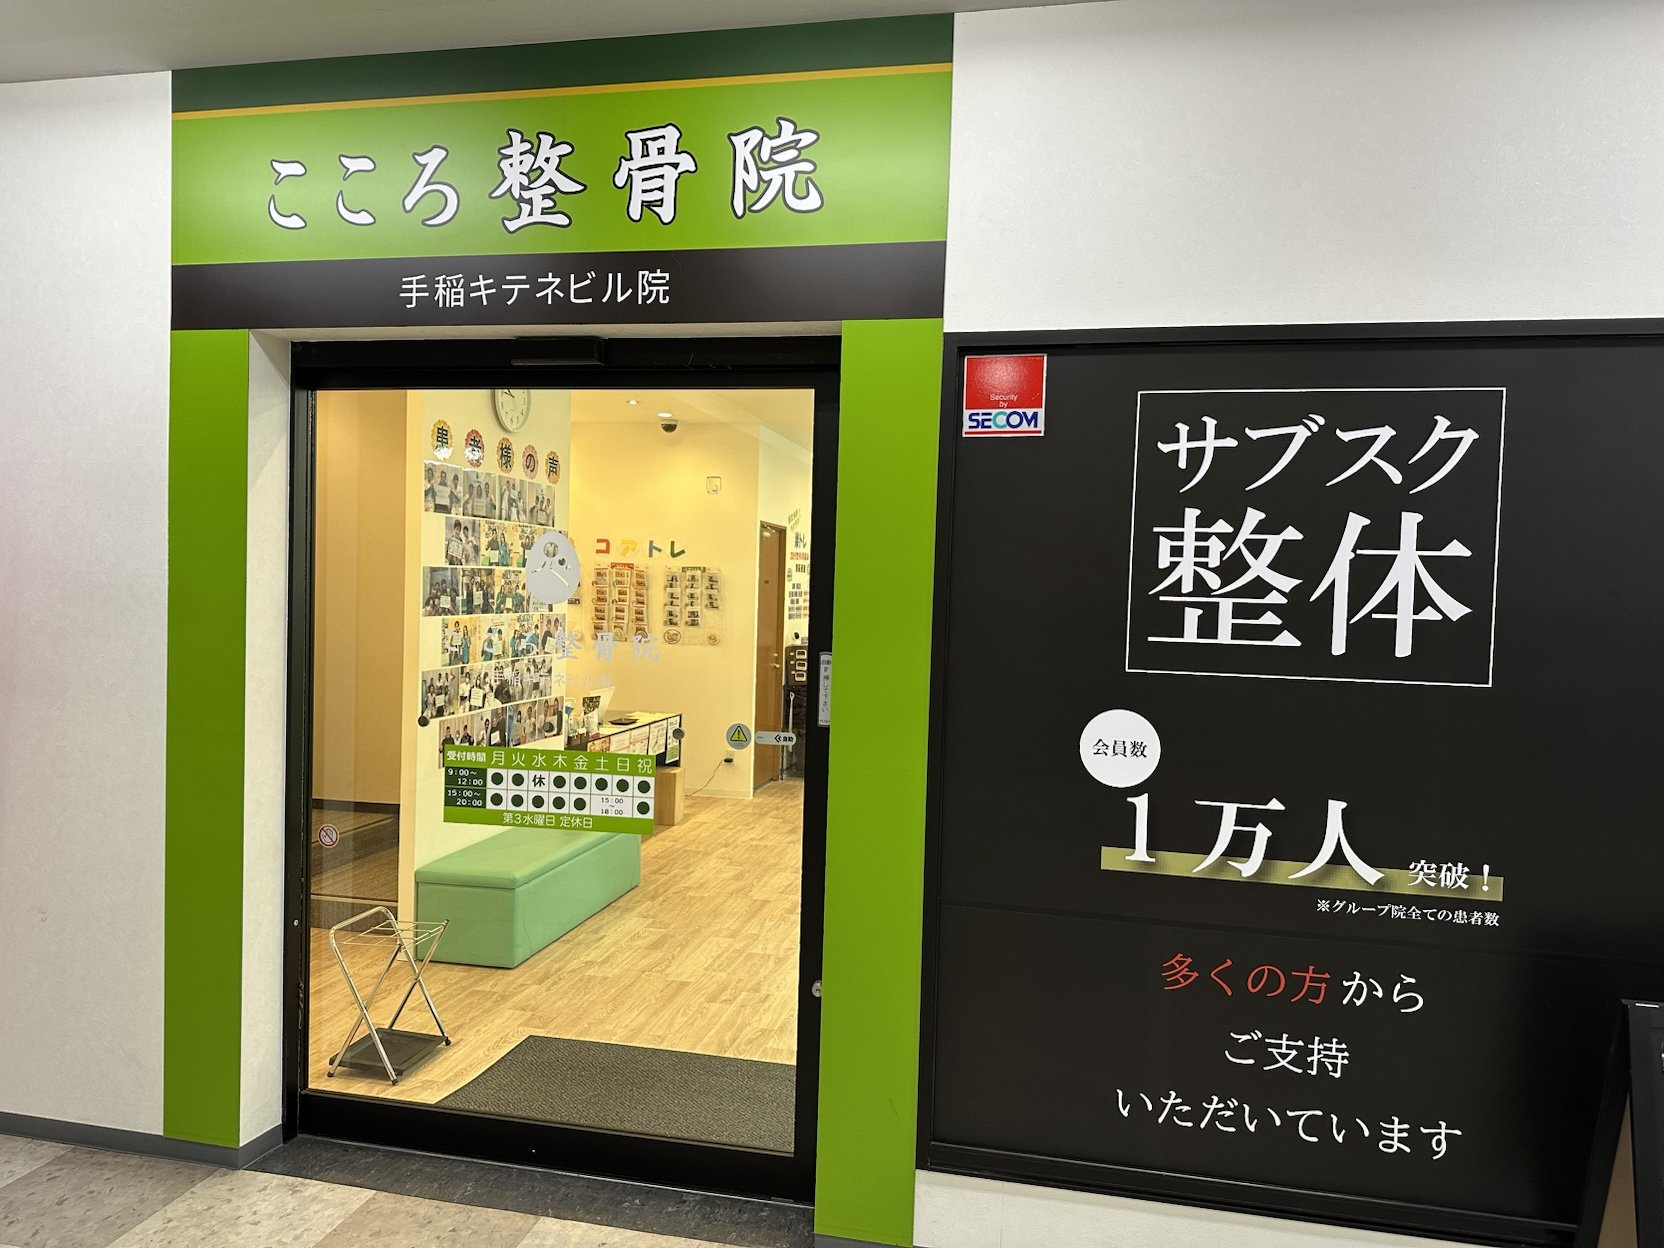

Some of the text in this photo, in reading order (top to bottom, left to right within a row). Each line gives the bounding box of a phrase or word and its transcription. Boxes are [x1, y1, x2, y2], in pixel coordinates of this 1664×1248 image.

[267, 117, 825, 234] こころ整骨院
[399, 268, 672, 310] 手稲キテネビル院
[989, 393, 1018, 402] Security
[999, 401, 1008, 409] by
[968, 410, 1039, 429] SECOM
[1157, 413, 1480, 495] サブスク
[595, 538, 686, 559] コアトレ
[1147, 506, 1473, 658] 整体
[446, 750, 486, 762] 受付時間
[1092, 737, 1148, 759] 会員数
[457, 777, 483, 787] 12:00
[531, 774, 546, 788] 休
[456, 798, 482, 807] 20:00
[503, 812, 593, 829] 第3水曜日 定休日
[1125, 793, 1491, 893] 1万人 突破！
[1224, 1028, 1351, 1079] ご支持
[1116, 1088, 1463, 1160] いただいています
